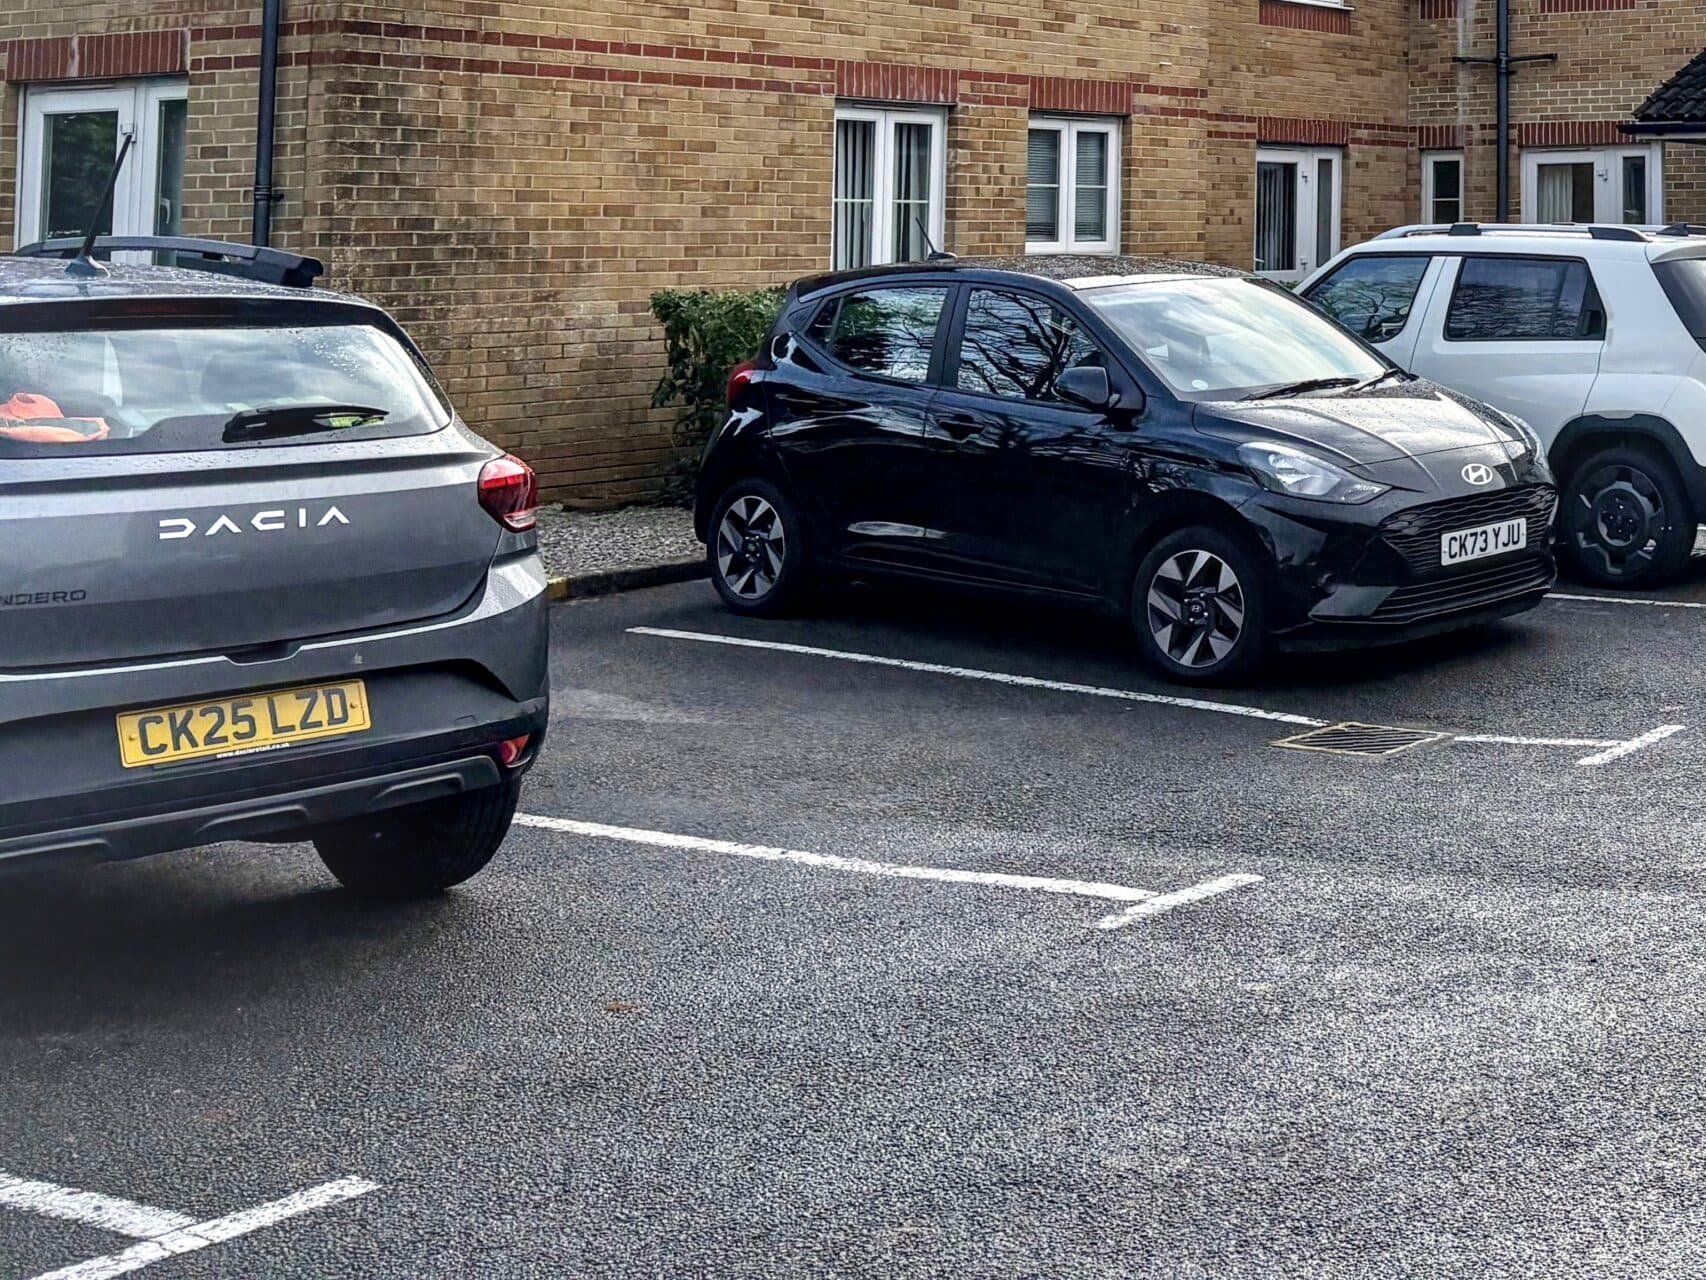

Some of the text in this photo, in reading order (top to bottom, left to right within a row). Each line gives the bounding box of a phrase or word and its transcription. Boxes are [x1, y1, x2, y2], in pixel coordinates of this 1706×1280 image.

[159, 505, 351, 540] DACIA
[1448, 522, 1521, 559] CK73 YJU
[137, 687, 349, 756] CK25 LZD
